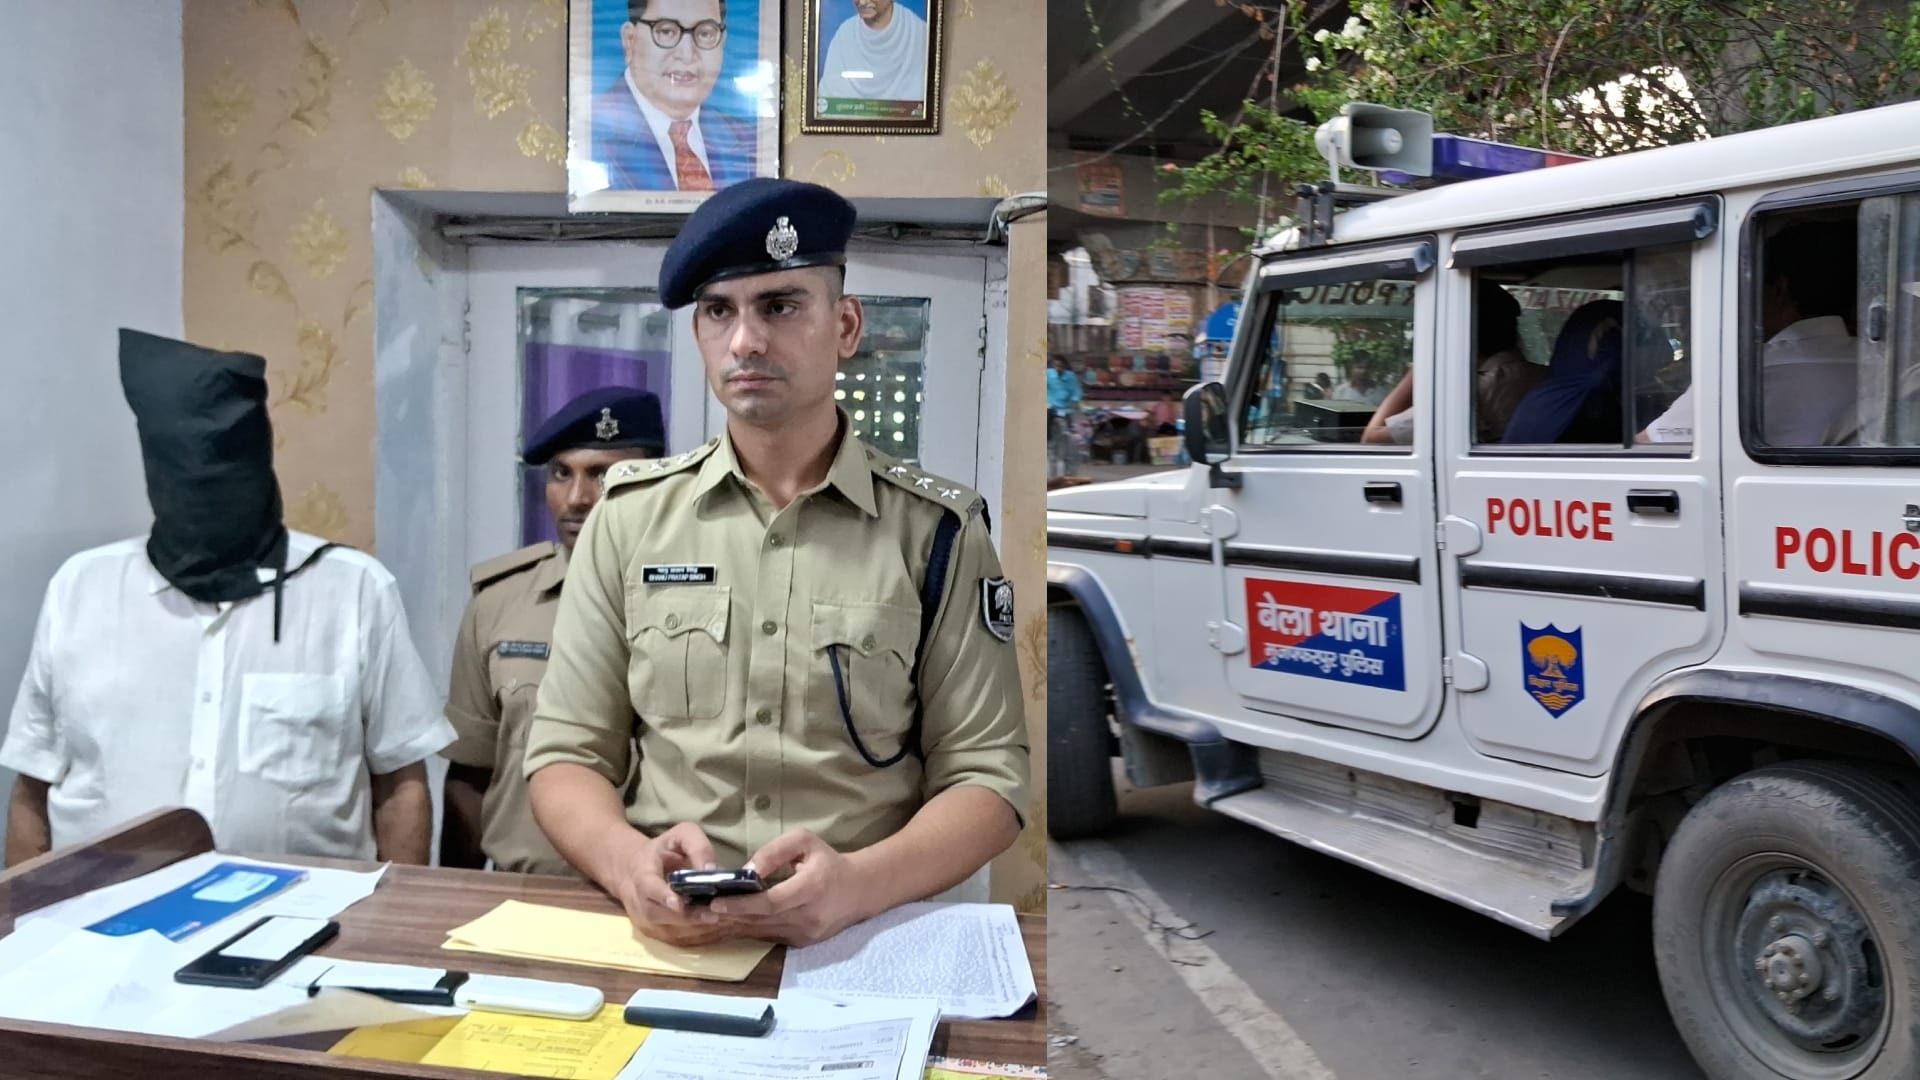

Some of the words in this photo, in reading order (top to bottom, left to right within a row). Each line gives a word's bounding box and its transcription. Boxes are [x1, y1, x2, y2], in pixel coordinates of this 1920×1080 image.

[1487, 497, 1614, 541] POLICE
[1775, 526, 1920, 580] POLIC
[1255, 591, 1314, 637] बेला
[1318, 610, 1389, 648] थाना
[1338, 649, 1385, 677] पुलिस
